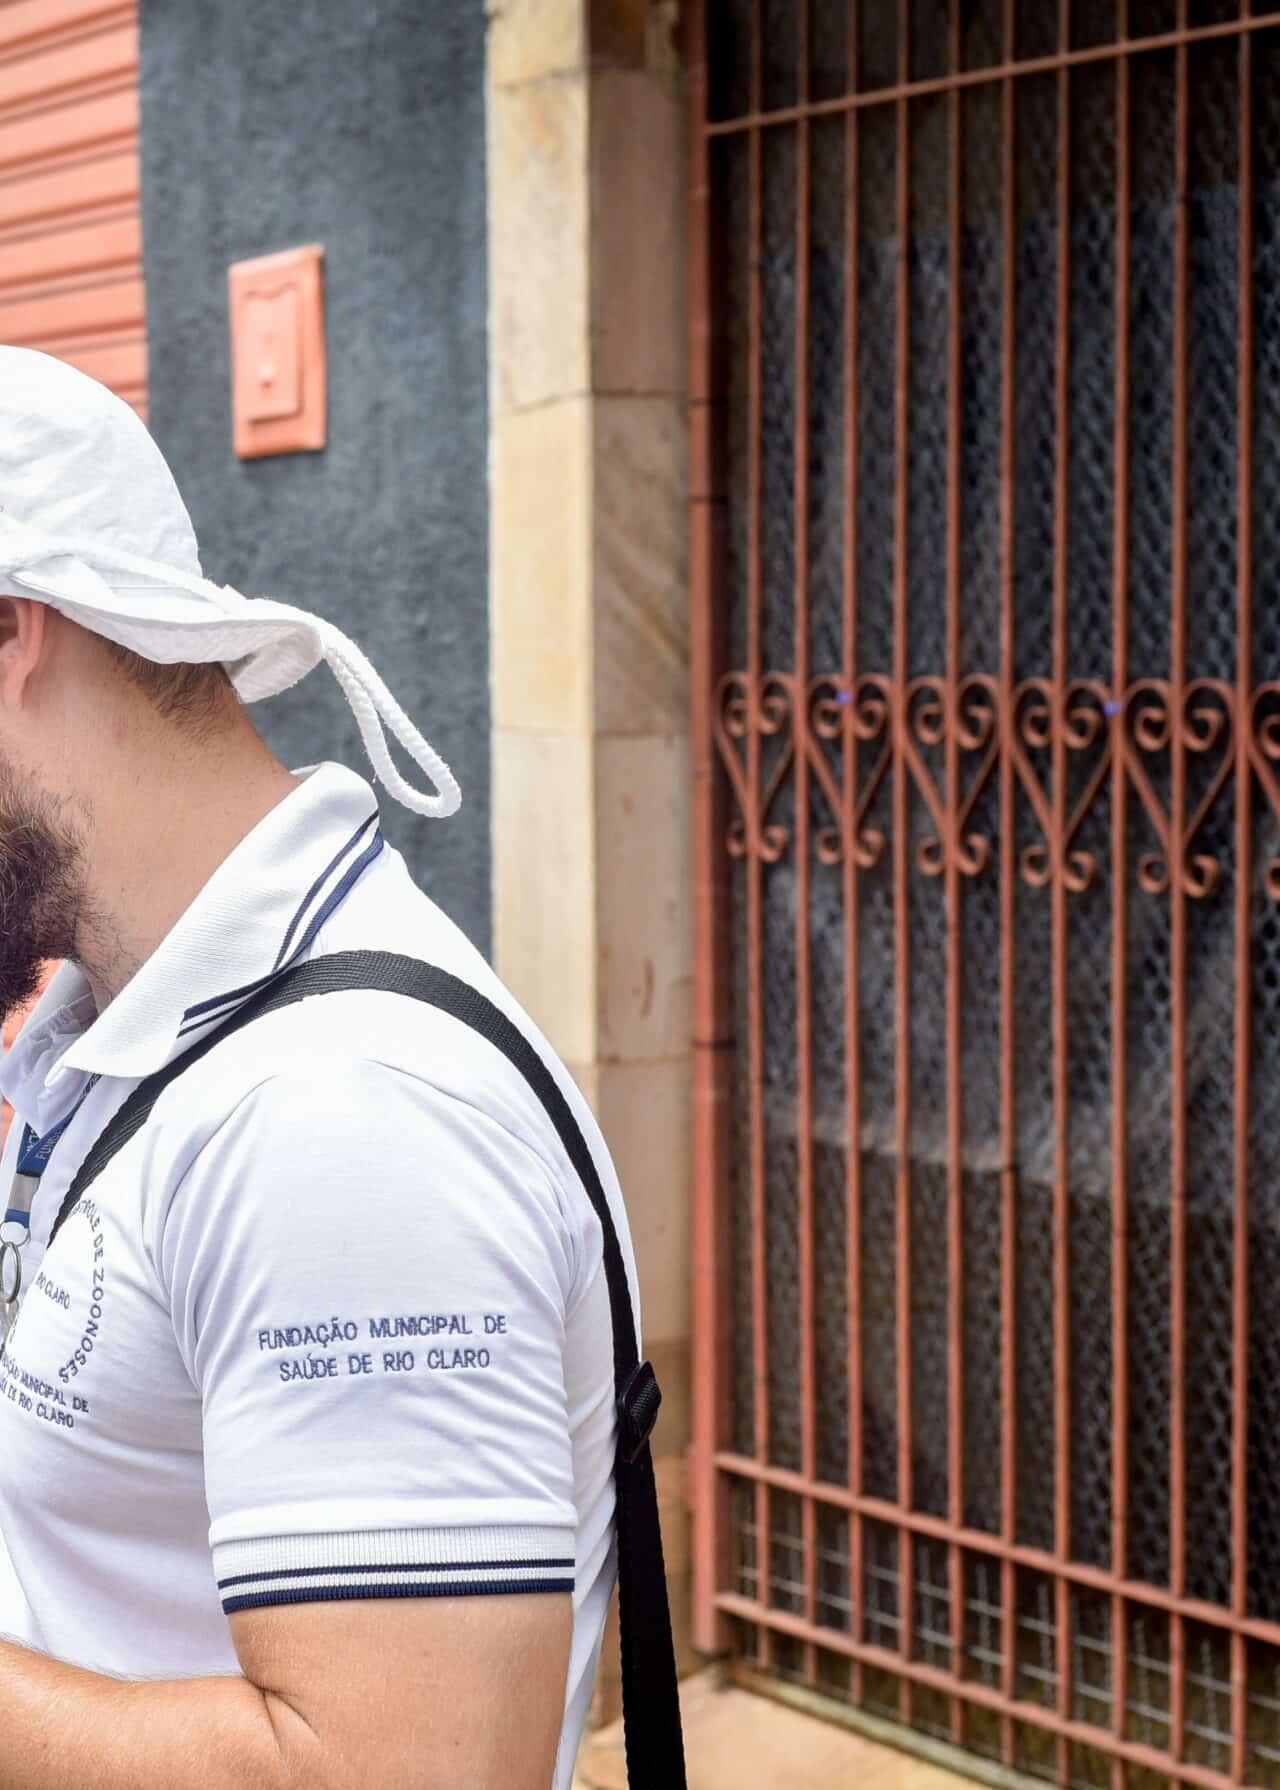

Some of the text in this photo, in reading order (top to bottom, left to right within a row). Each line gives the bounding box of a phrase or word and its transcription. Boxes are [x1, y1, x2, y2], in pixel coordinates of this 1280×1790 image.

[93, 1233, 104, 1263] DE
[44, 1279, 71, 1310] CLARO
[58, 1267, 104, 1384] ZOONOSES
[257, 1314, 508, 1351] FUNDAÇÃO MUNICIPAL DE
[278, 1348, 491, 1382] SAÚDE DE RIO CLARO
[19, 1370, 67, 1406] MUNICIPAL
[72, 1396, 89, 1413] DE
[18, 1392, 33, 1412] RIO
[36, 1402, 74, 1428] CLARO
